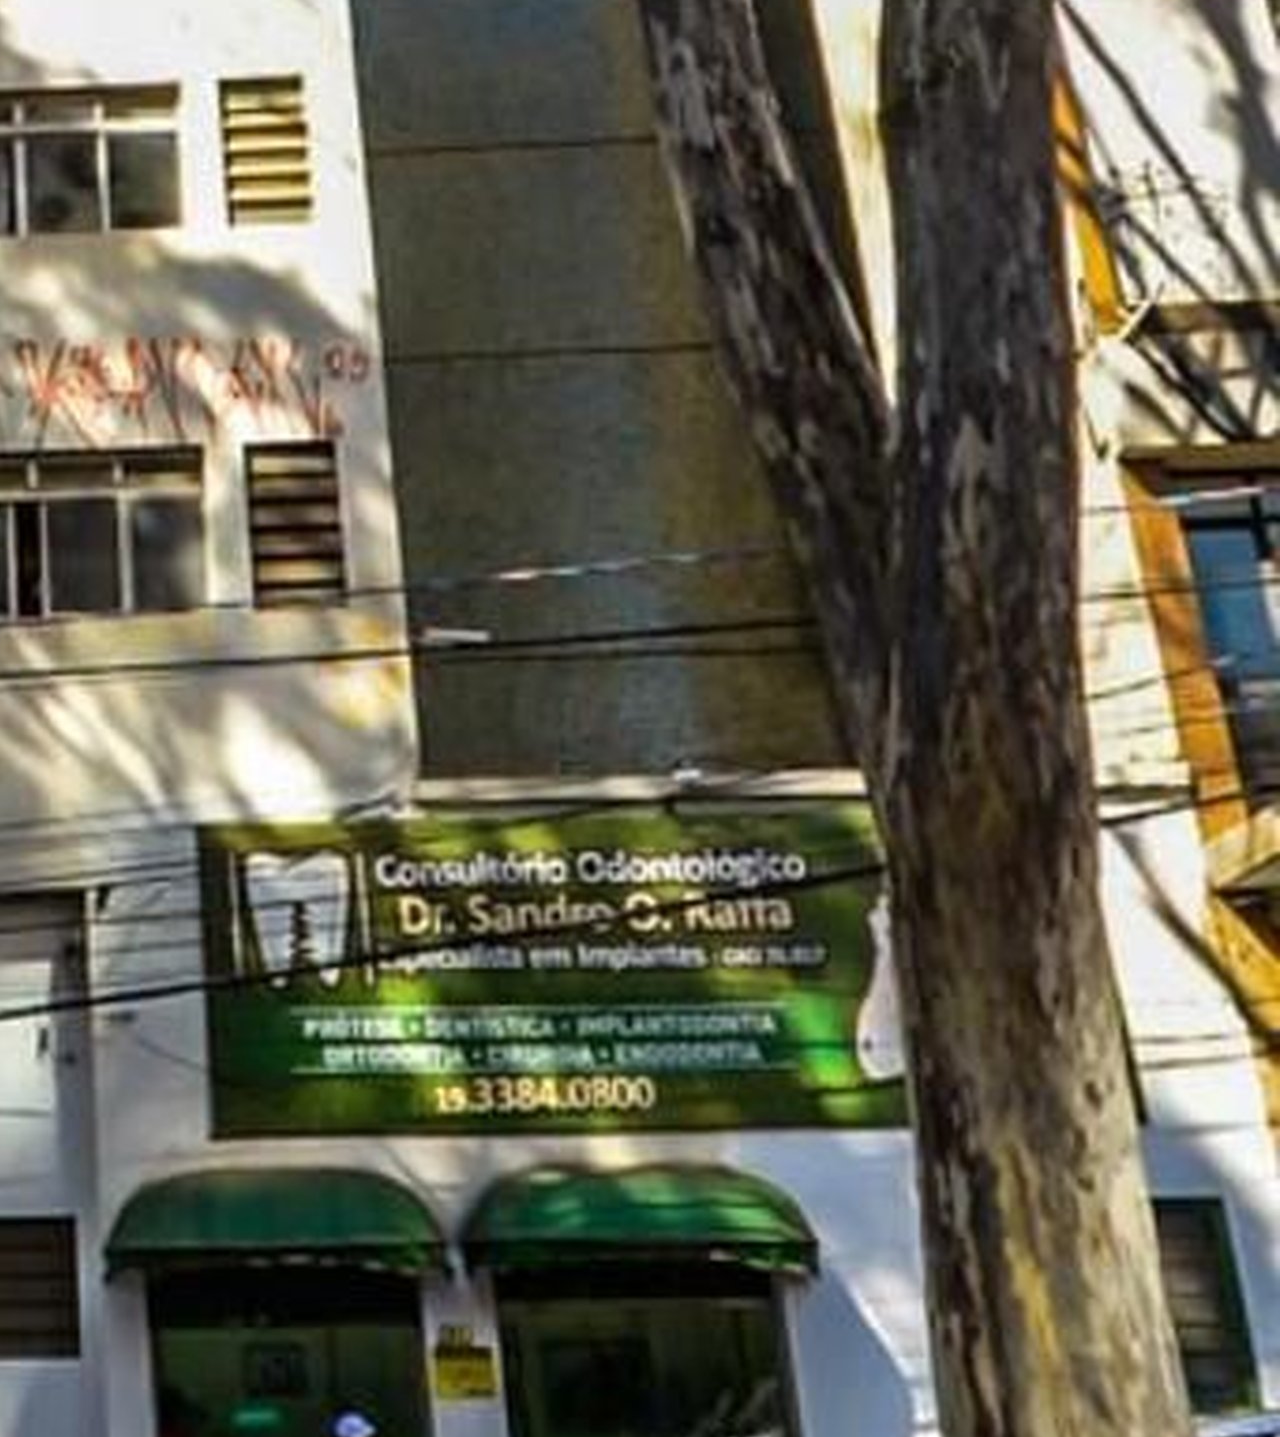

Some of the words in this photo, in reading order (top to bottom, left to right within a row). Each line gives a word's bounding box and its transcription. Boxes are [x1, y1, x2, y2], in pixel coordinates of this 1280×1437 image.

[375, 852, 568, 888] Consultório
[577, 847, 806, 889] Odontológico
[400, 895, 457, 934] Dr.
[467, 892, 616, 933] Sandro
[529, 944, 572, 969] em
[576, 939, 707, 973] Implantes
